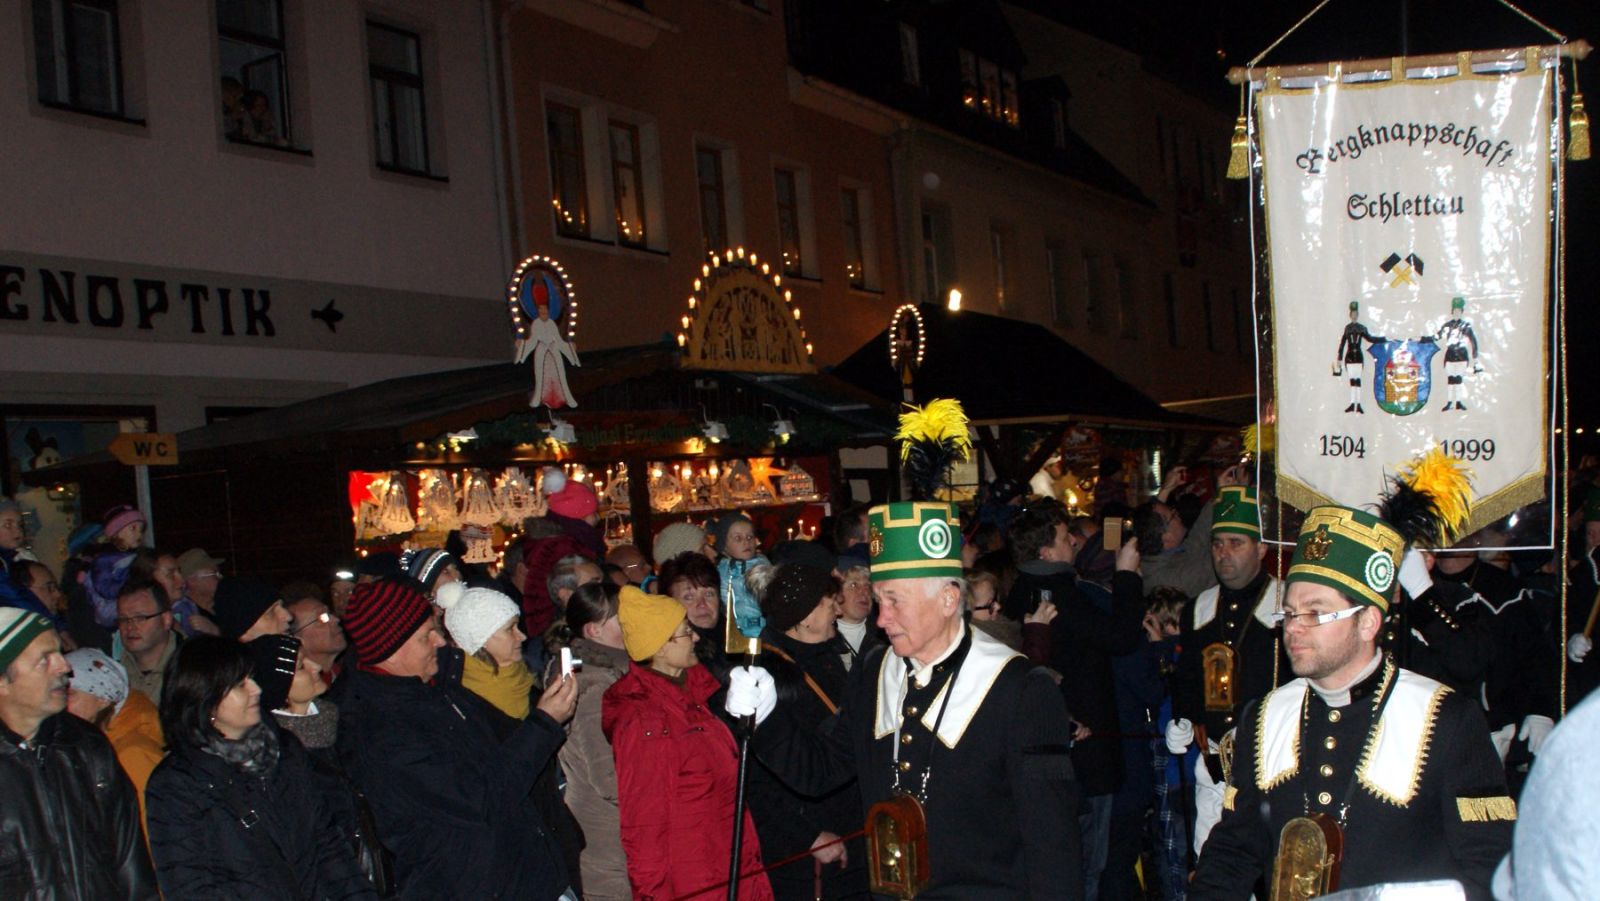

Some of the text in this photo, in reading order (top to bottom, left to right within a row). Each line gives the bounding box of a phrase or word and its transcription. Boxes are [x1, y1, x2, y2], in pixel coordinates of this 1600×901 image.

[1347, 192, 1464, 224] Schlettau
[133, 441, 168, 457] WC
[1320, 434, 1365, 459] 1504
[1440, 438, 1496, 462] 1999
